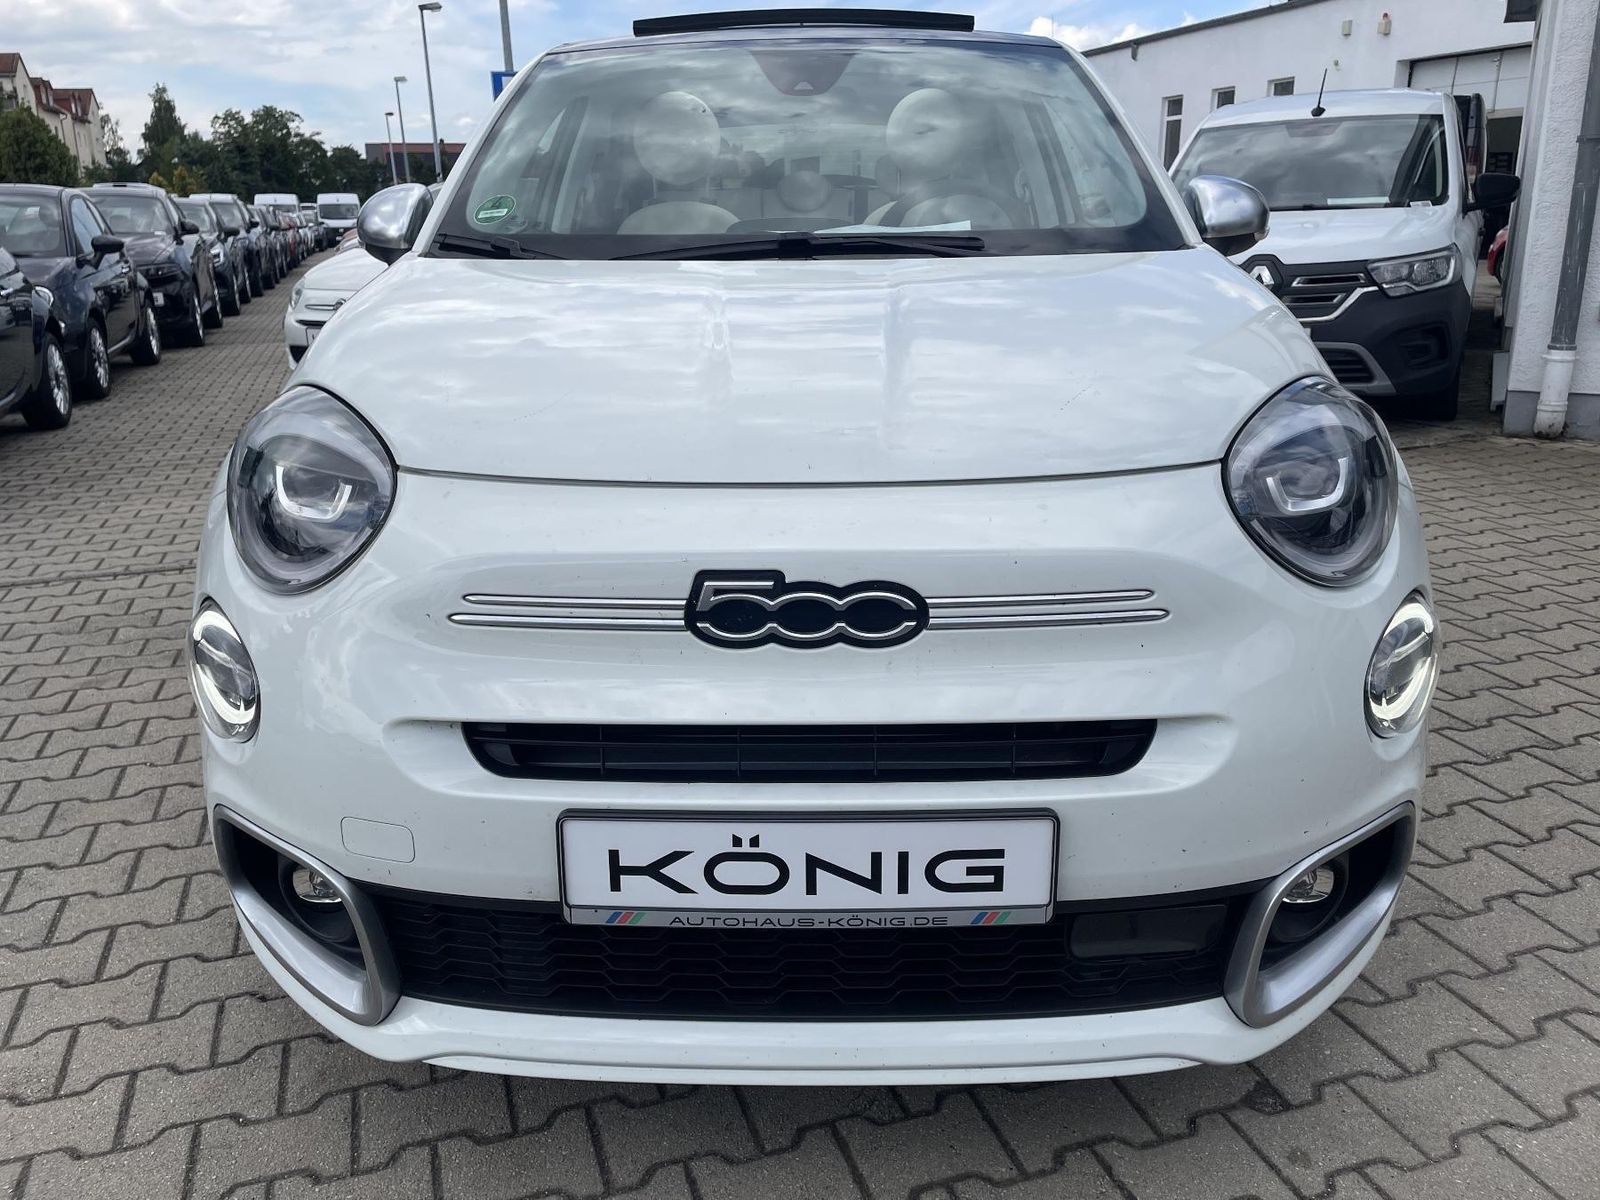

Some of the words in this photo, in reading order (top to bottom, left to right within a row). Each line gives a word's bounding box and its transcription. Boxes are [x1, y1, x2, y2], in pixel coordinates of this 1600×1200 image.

[693, 578, 919, 643] 500
[607, 833, 1006, 896] KÖNIG
[669, 914, 949, 928] AUTOHAUS-KÖNIG.DE
